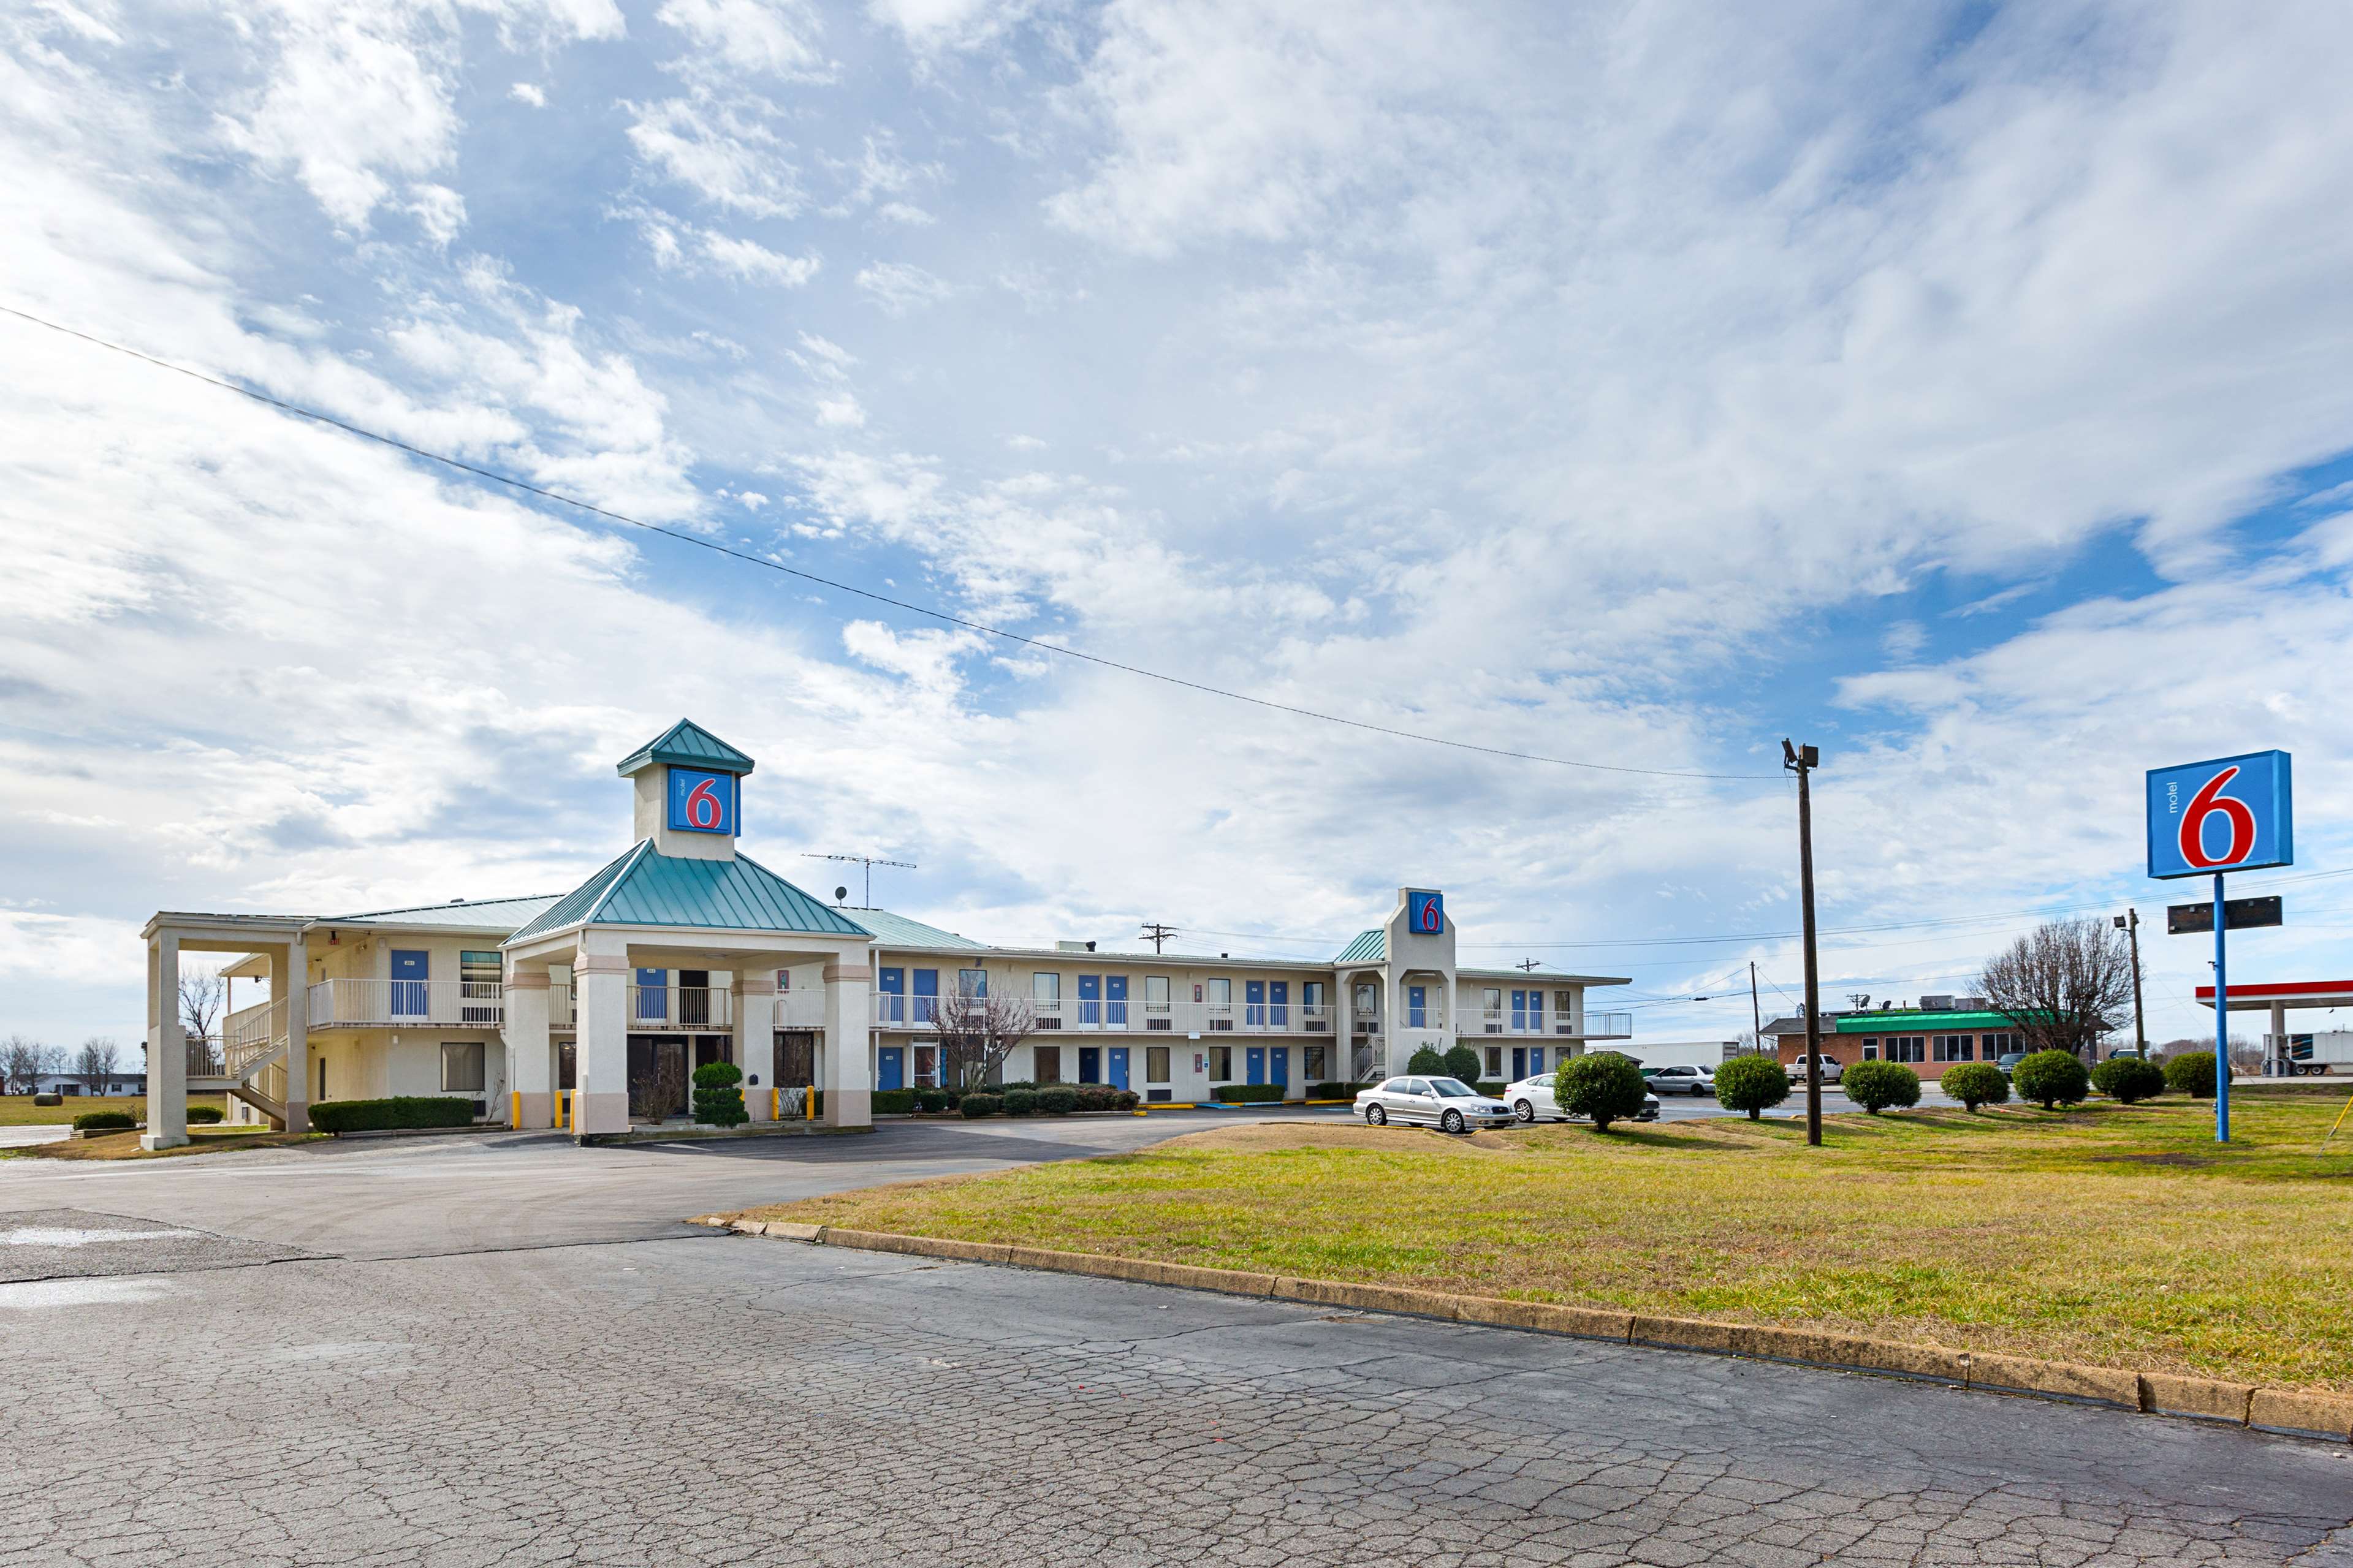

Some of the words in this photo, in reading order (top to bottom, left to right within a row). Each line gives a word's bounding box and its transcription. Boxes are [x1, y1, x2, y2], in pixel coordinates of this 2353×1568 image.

[686, 778, 723, 829] 6
[2167, 782, 2178, 814] motel
[2178, 765, 2257, 868] 6
[1422, 897, 1440, 931] 6
